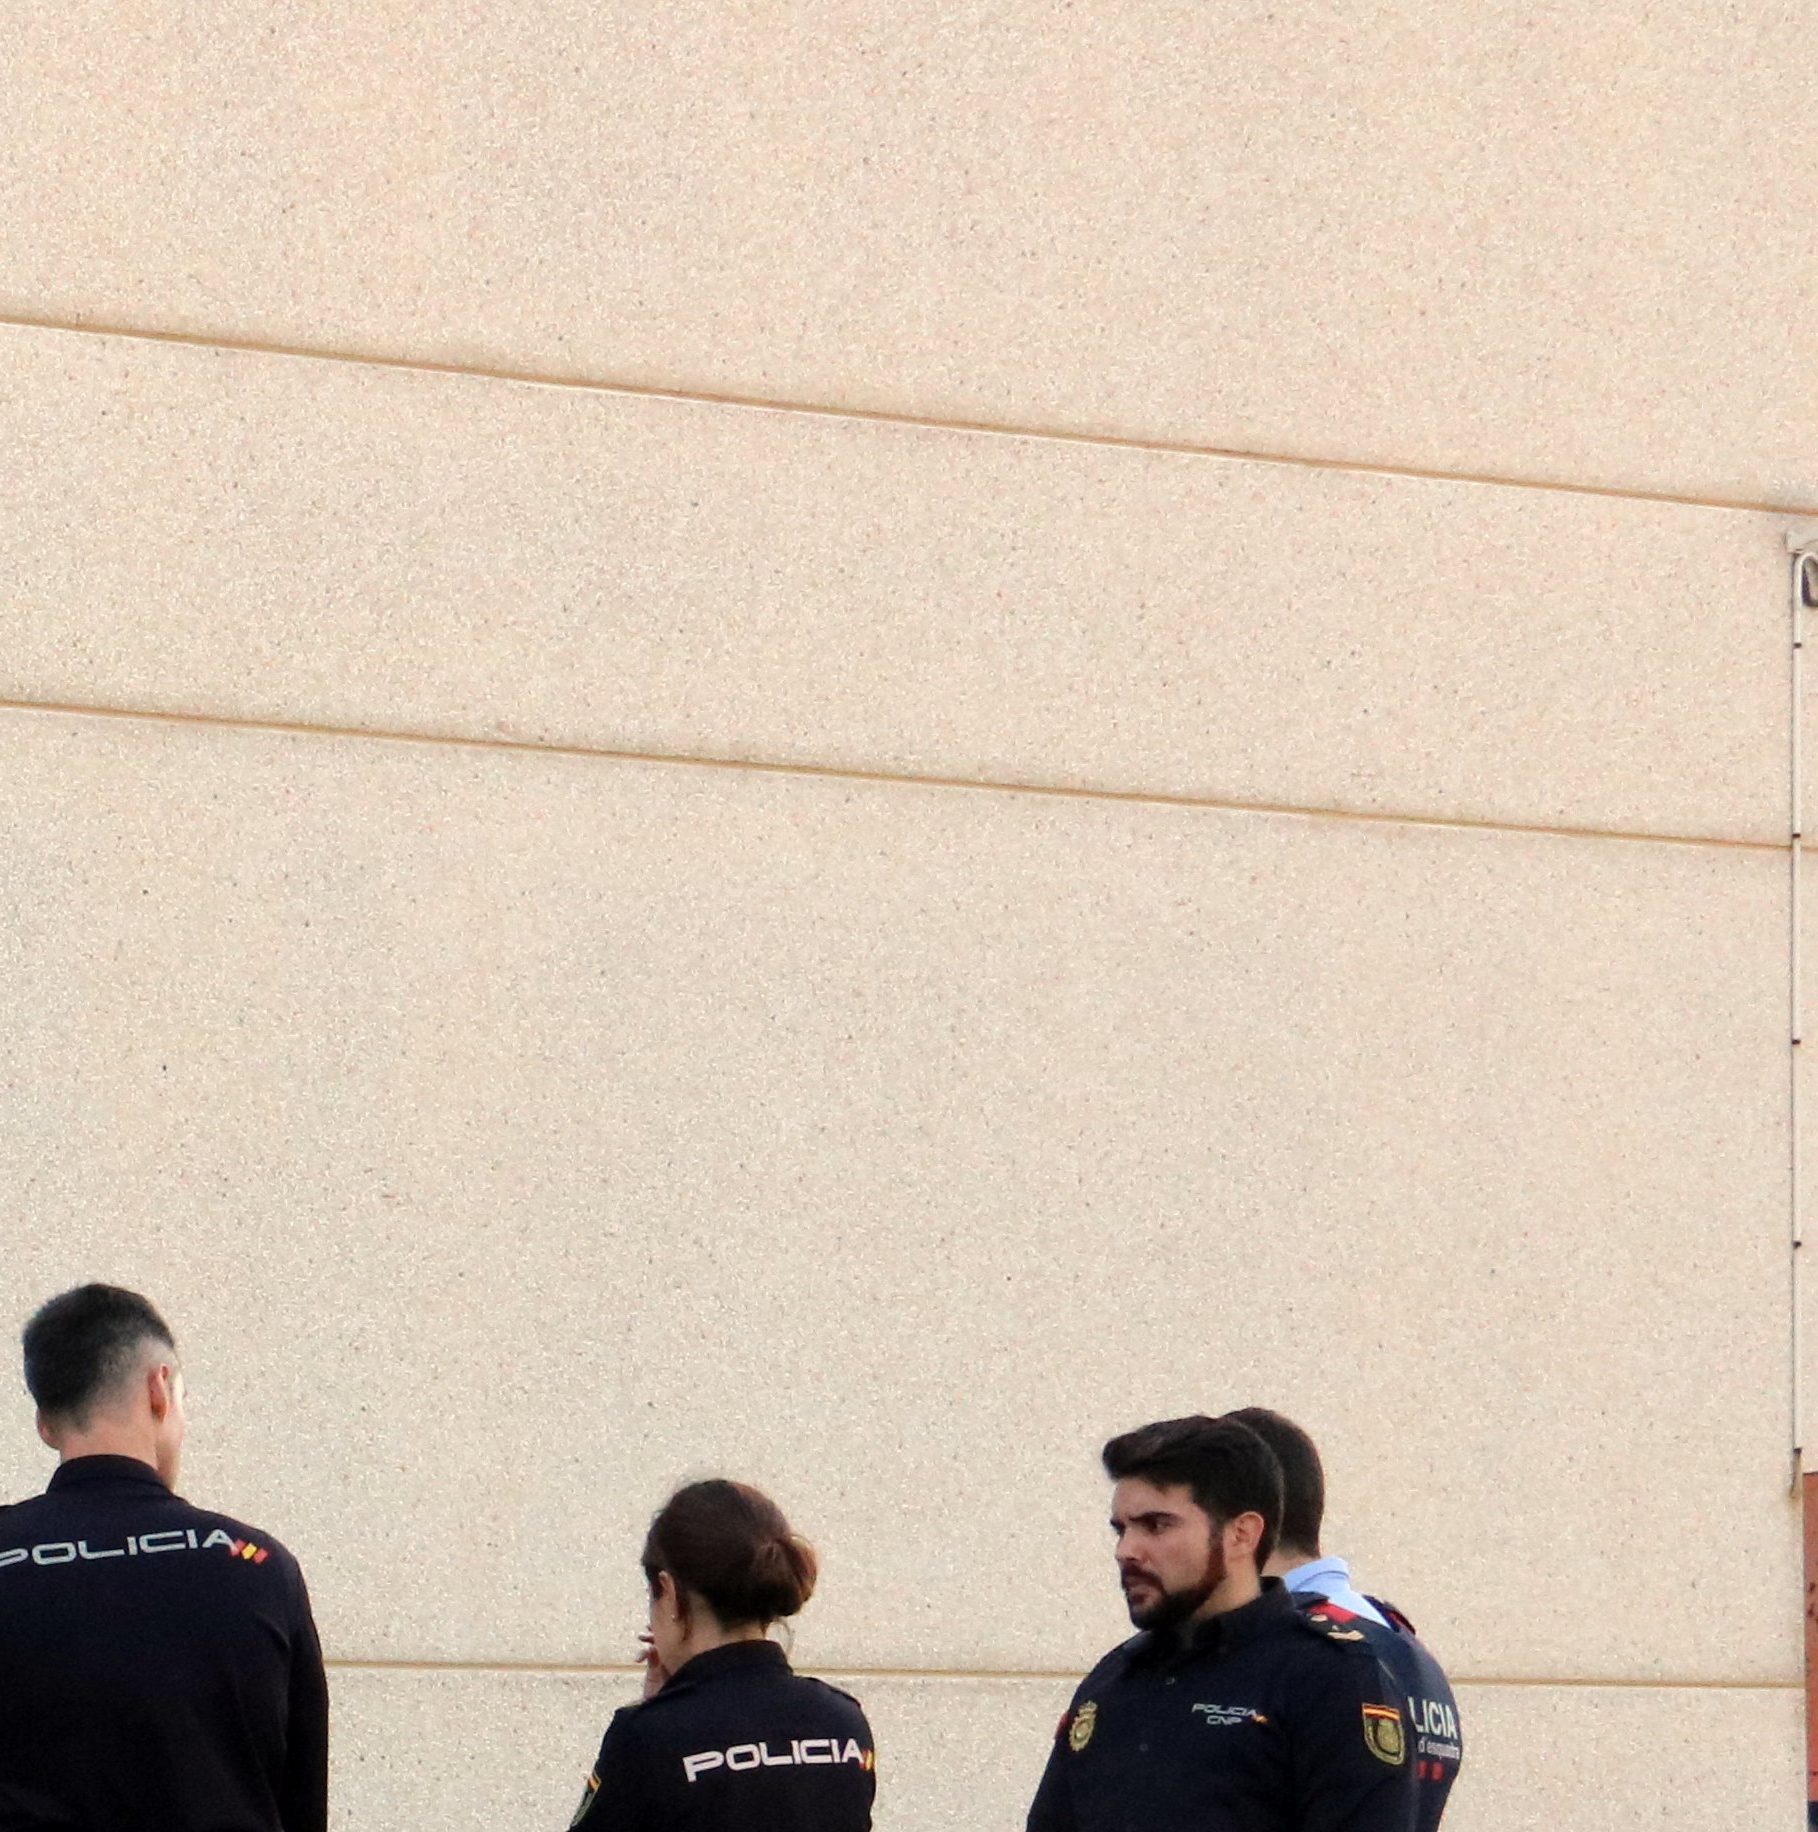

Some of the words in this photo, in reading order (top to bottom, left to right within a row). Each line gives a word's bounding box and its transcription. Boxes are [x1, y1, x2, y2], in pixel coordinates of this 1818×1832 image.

[1191, 1703, 1258, 1717] POLICIA
[1206, 1715, 1243, 1727] CNP
[1406, 1695, 1459, 1740] LICIA
[682, 1738, 865, 1783] POLICIA
